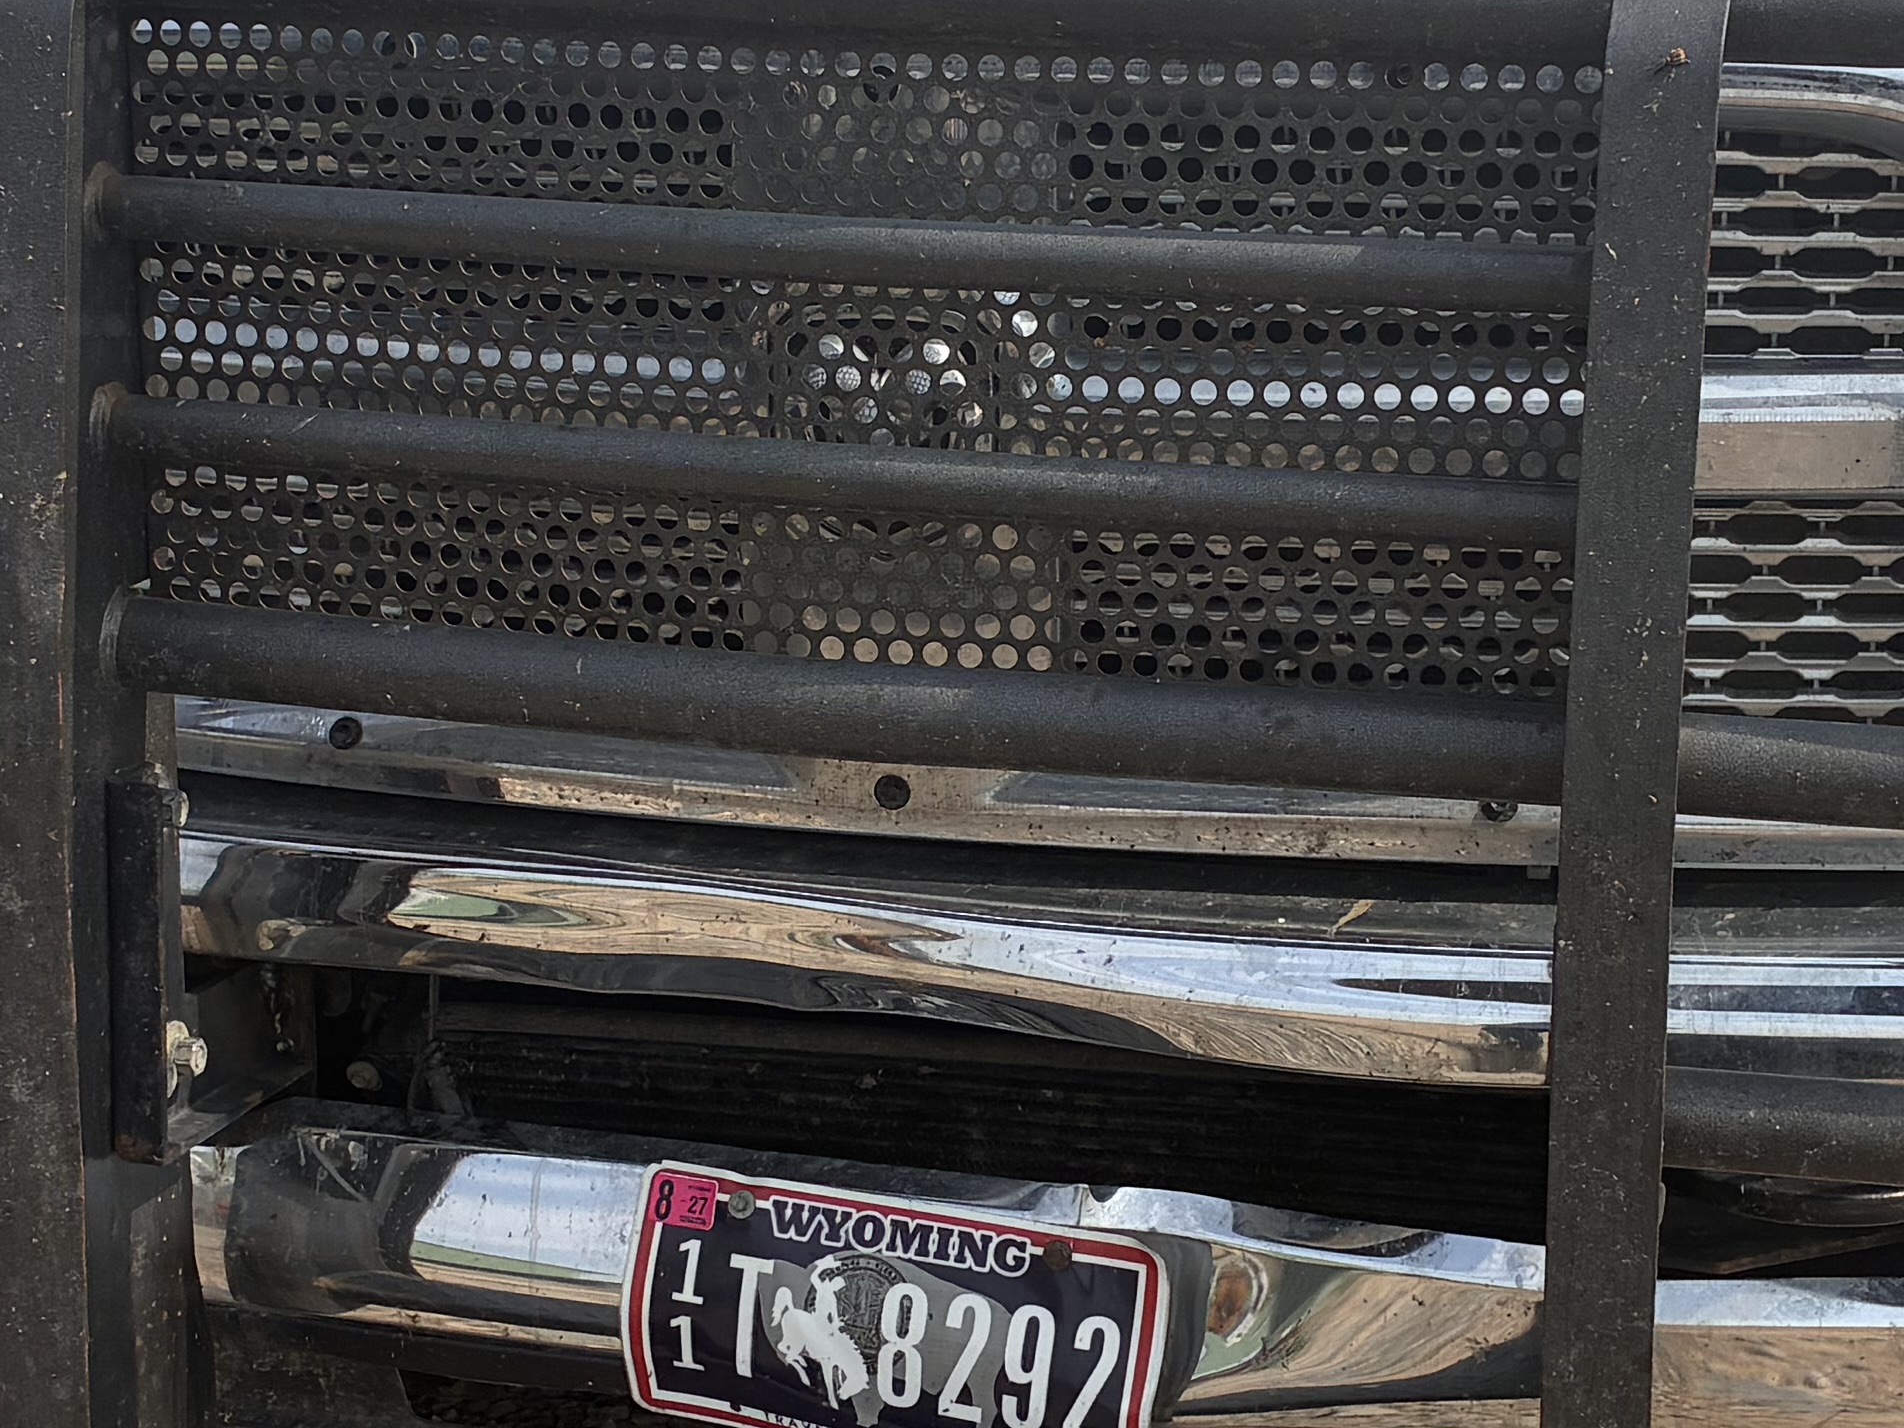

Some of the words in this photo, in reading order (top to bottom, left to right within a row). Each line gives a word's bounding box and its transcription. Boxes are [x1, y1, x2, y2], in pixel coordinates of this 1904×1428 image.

[655, 1179, 674, 1221] 8
[687, 1195, 709, 1216] 27
[770, 1196, 1031, 1277] WYOMING
